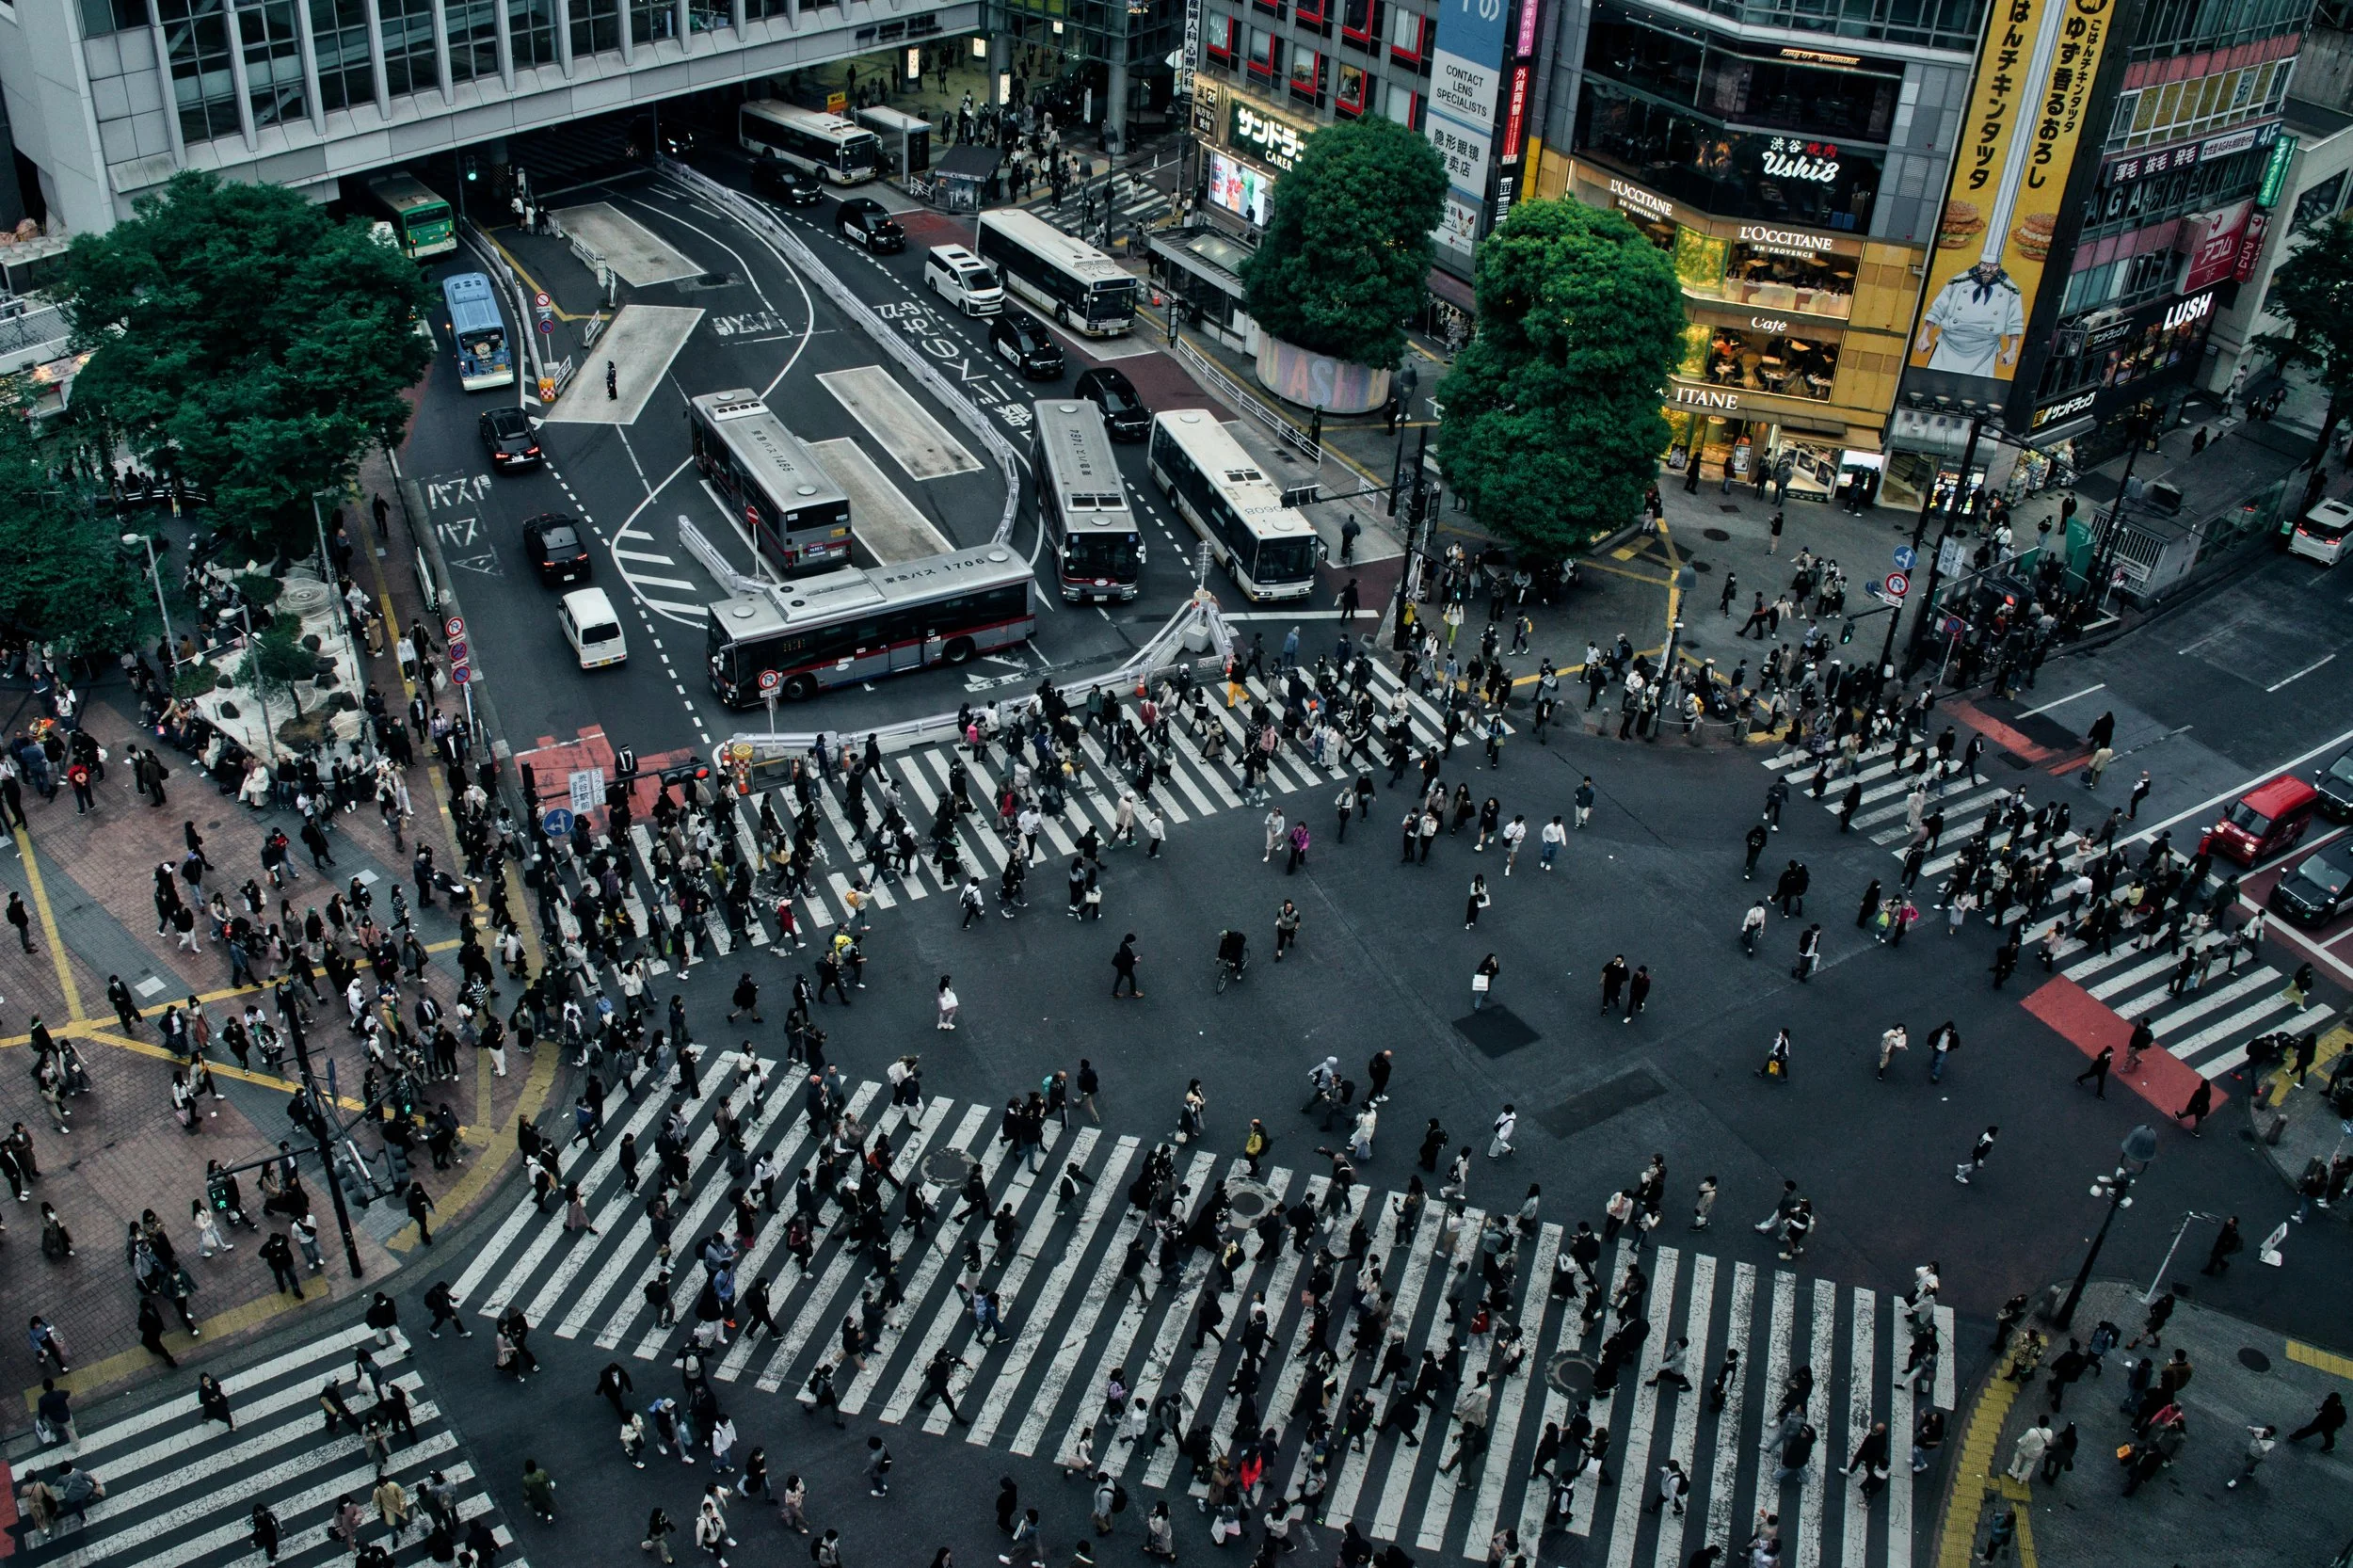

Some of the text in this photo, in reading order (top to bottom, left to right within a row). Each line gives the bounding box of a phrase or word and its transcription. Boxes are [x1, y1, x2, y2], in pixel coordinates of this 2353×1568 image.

[1518, 45, 1529, 55] 4F
[1446, 65, 1483, 88] CONTACT
[1452, 81, 1473, 98] LENS
[1437, 88, 1487, 117] SPECIALISTS
[2028, 16, 2087, 189] ゆず香るおろし
[1433, 128, 1481, 162] 隐形眼镜
[2259, 123, 2281, 144] 4F
[1610, 179, 1673, 216] L'OCCITANE
[1740, 226, 1833, 251] L'OCCITANE
[1769, 246, 1814, 259] PROVENCE
[2201, 236, 2233, 264] アコム
[2163, 292, 2214, 330] LUSH
[2051, 392, 2096, 420] サンドラッグ
[437, 518, 479, 548] バス
[884, 558, 986, 584] 東急バス 1706
